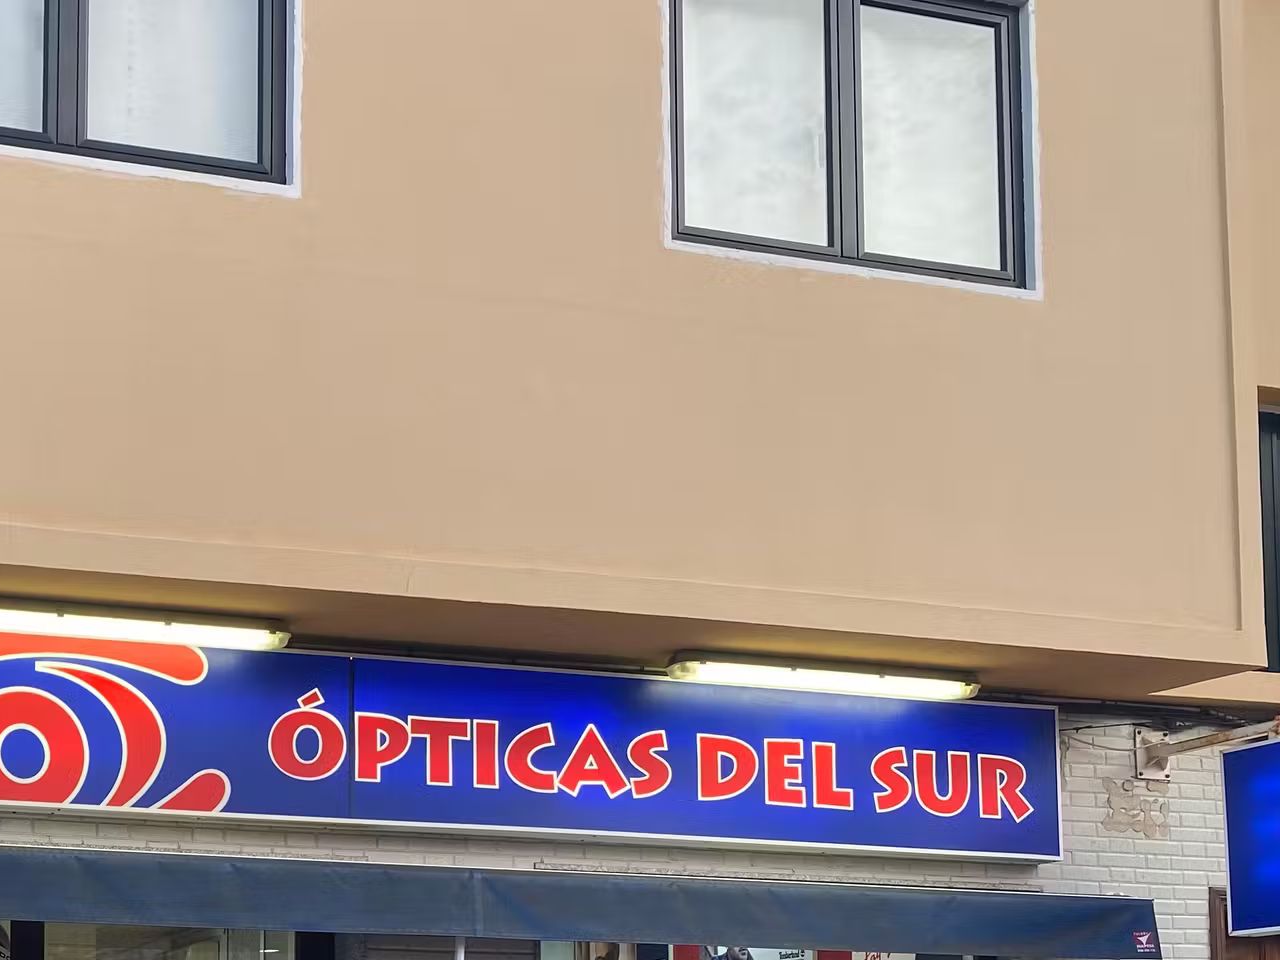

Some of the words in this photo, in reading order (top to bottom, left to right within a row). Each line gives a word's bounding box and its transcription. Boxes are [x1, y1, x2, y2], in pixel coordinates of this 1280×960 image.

[267, 687, 672, 800] ÓPTICAS
[696, 732, 854, 811] DEL
[870, 745, 1035, 824] SUR
